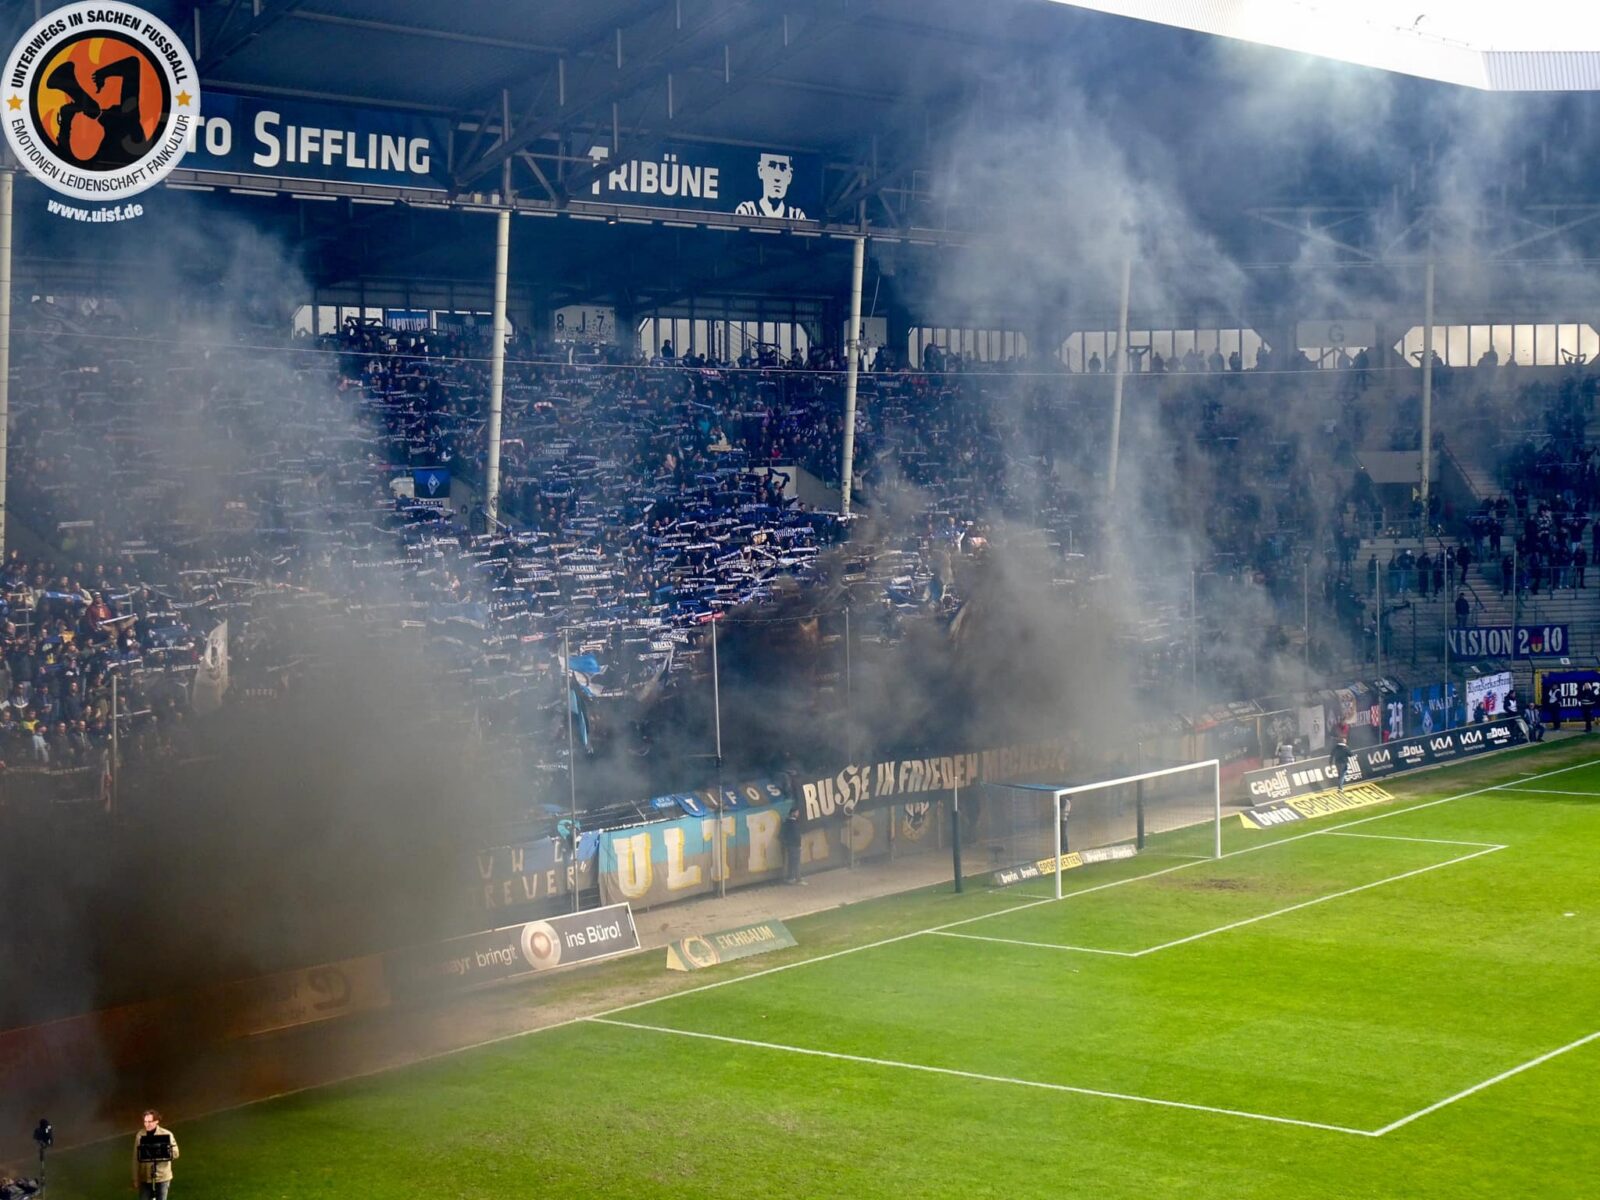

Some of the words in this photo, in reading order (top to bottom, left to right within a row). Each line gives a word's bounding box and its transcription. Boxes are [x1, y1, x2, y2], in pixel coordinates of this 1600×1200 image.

[556, 314, 565, 331] 8
[1328, 324, 1345, 343] G
[1450, 628, 1512, 656] VISION
[875, 760, 896, 797] IN
[1250, 769, 1290, 798] capelli
[1250, 805, 1300, 826] bwin
[566, 931, 585, 949] ins
[586, 922, 622, 945] Büro!
[716, 926, 775, 949] EICHBAUM
